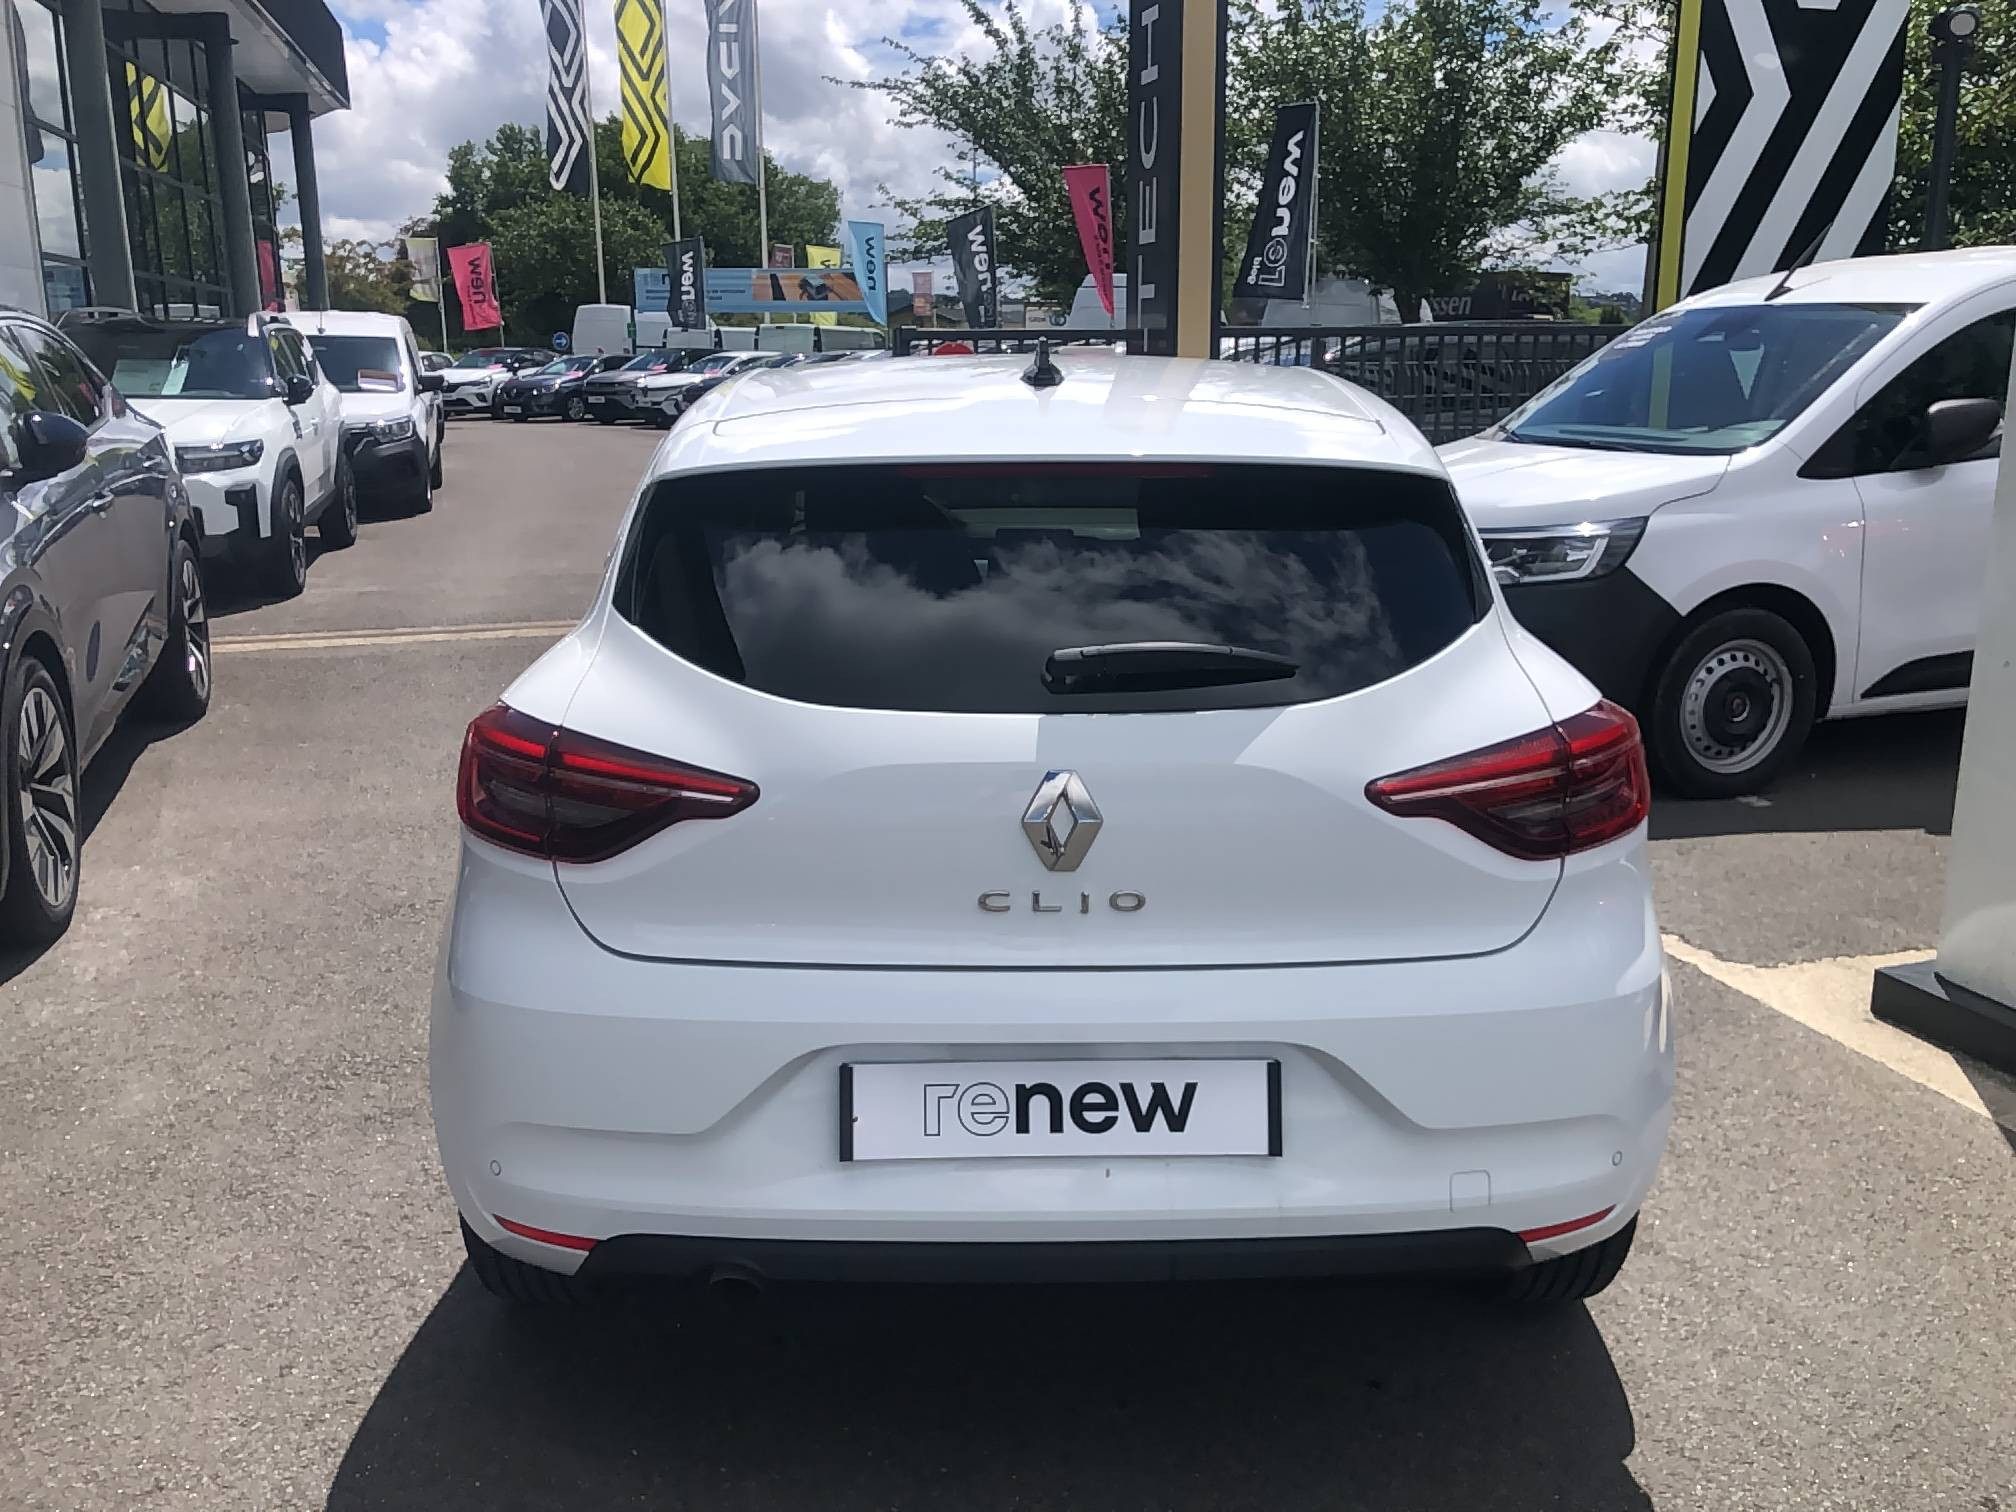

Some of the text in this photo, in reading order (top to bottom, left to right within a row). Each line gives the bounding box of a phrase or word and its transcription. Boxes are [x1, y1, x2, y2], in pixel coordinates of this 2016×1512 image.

[1430, 295, 1472, 315] ssen
[977, 889, 1147, 914] CLIO
[923, 1081, 1198, 1137] renew
